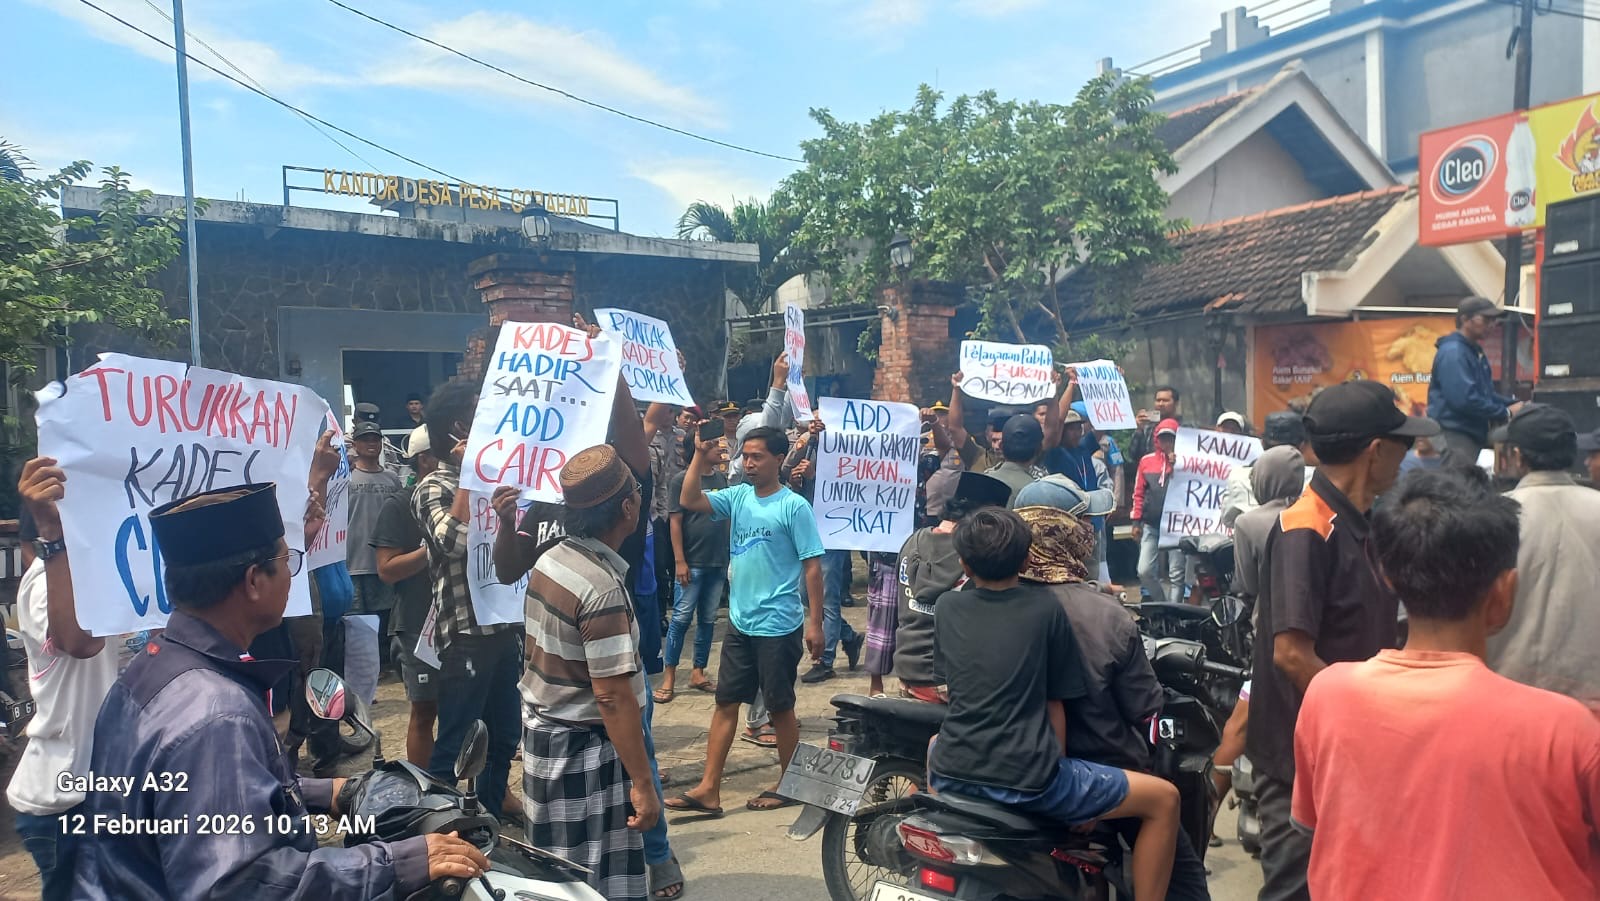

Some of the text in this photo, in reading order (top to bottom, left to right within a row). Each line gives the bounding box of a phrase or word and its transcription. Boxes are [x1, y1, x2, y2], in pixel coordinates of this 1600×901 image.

[1444, 158, 1484, 186] Cleo
[324, 168, 398, 200] KANTOR
[403, 178, 452, 206] DESA
[459, 183, 501, 211] PESA
[513, 325, 593, 361] KADES
[622, 341, 667, 373] KADES
[498, 352, 605, 393] HADIR
[80, 367, 298, 450] TURUNKAN
[495, 403, 564, 441] ADD
[843, 401, 891, 433] ADD
[1094, 401, 1127, 424] KITA
[823, 431, 876, 457] UNTUK
[1197, 434, 1251, 461] KAMU
[474, 439, 566, 493] CAIR
[821, 480, 910, 510] UNTUK KAU
[825, 504, 899, 536] SIKAT
[856, 763, 873, 785] J
